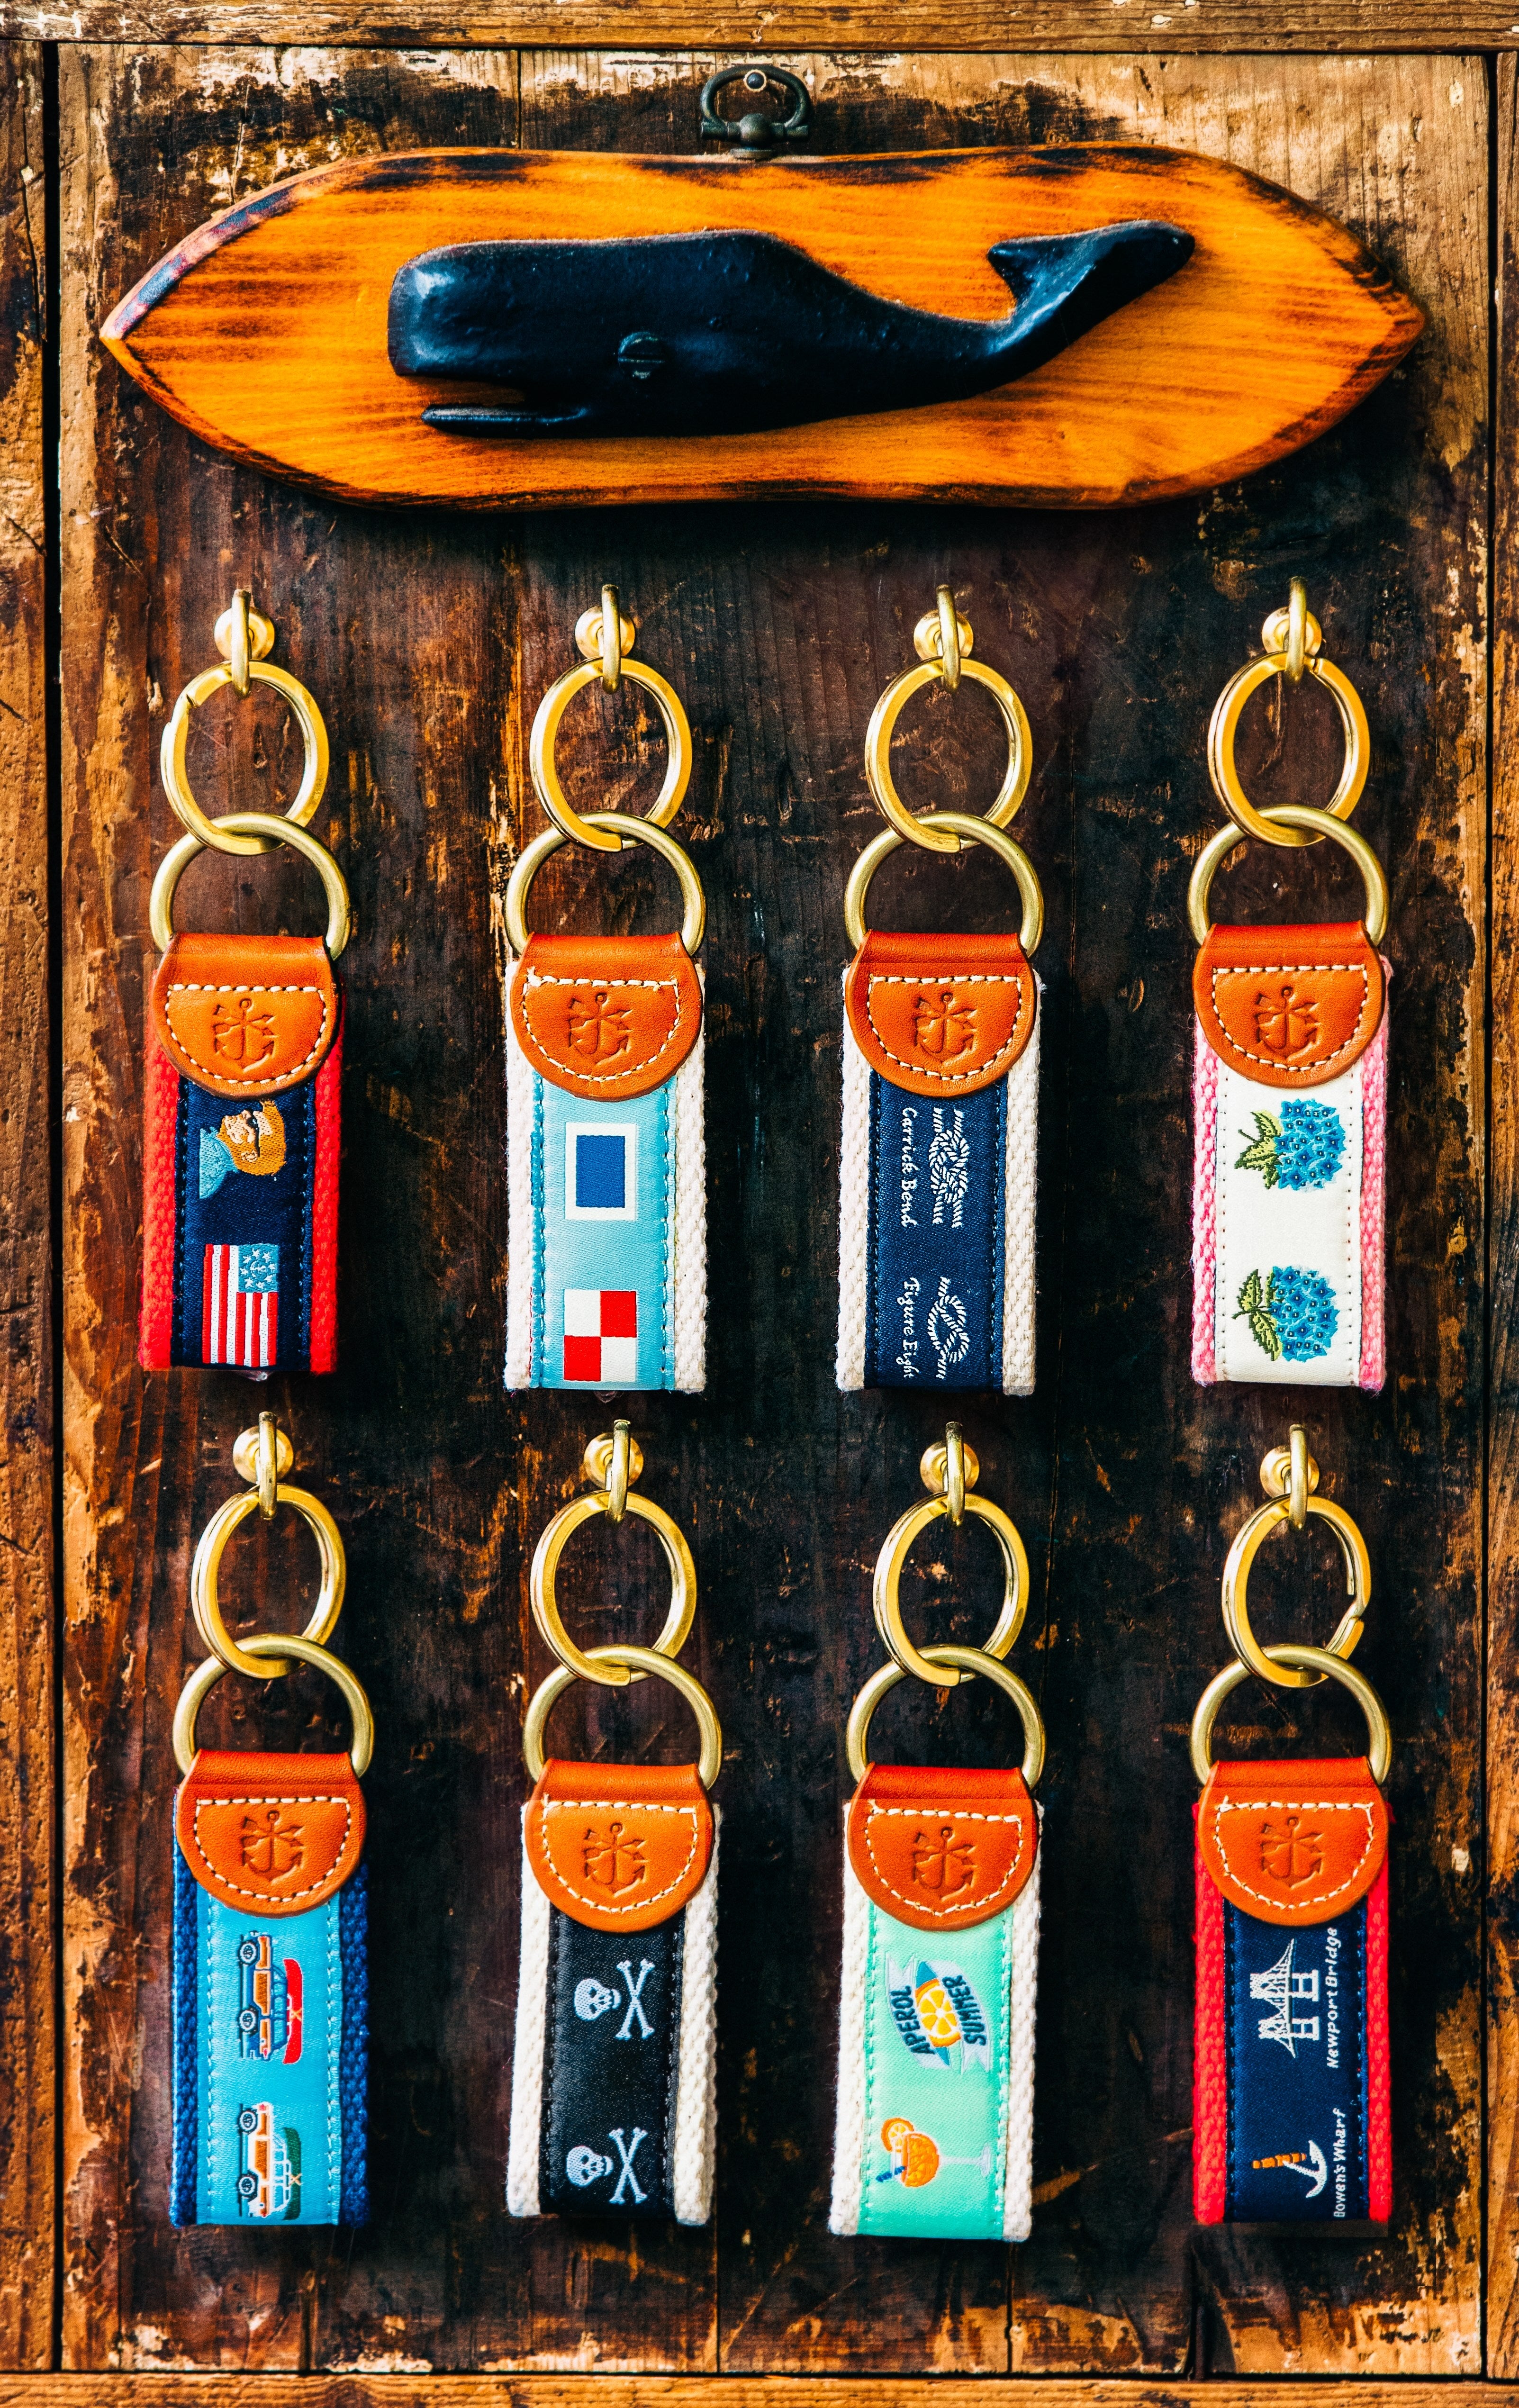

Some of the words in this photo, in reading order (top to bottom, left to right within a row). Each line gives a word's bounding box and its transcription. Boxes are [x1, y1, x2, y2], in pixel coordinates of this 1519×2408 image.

[901, 1107, 919, 1174] Carrick
[901, 1179, 918, 1227] Bend
[896, 1277, 920, 1336] Figure
[895, 1339, 920, 1378] Eight
[1325, 1927, 1342, 1988] Bridge
[890, 1985, 936, 2055] APEROL
[941, 1974, 987, 2046] SUMMER
[1326, 1990, 1340, 2069] Newport
[1332, 2107, 1346, 2162] Wharf
[1333, 2164, 1346, 2218] Bowen's
